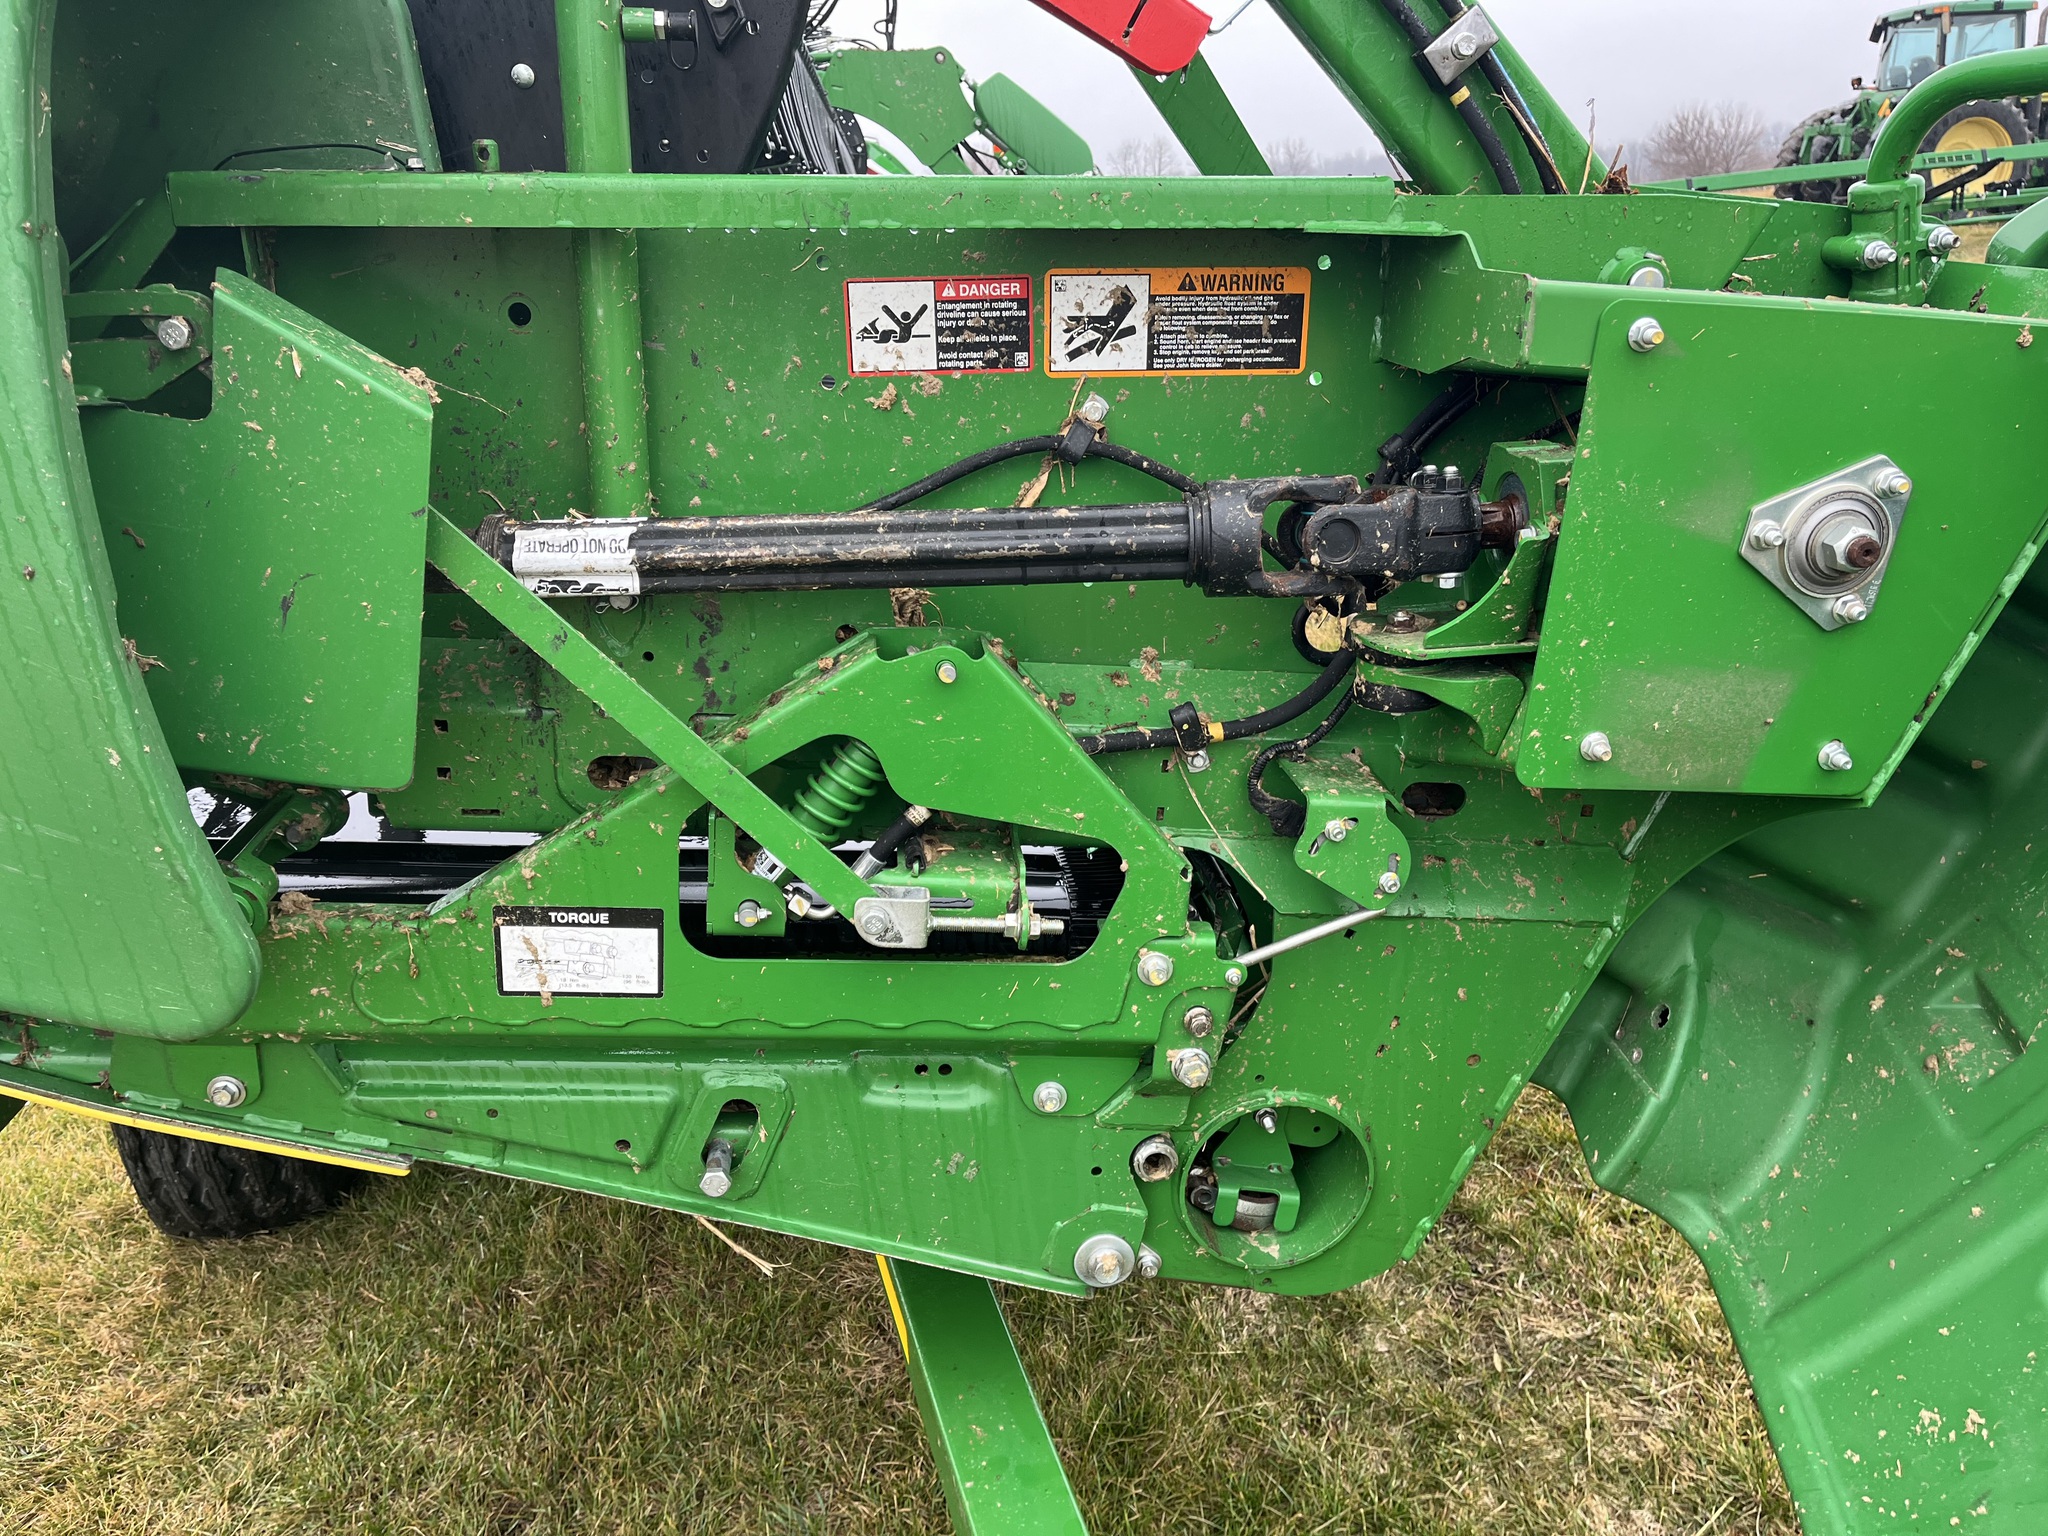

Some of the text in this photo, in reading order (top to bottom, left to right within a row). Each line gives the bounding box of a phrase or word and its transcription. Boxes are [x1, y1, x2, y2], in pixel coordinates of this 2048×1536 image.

[1200, 274, 1284, 291] WARNING
[959, 283, 1020, 296] DANGER
[936, 302, 982, 310] Entanglement
[992, 301, 1017, 309] rotating
[937, 320, 956, 328] injury
[938, 336, 955, 344] Keep
[999, 334, 1018, 343] place.
[939, 360, 985, 368] rotating parts.
[524, 538, 578, 553] OPERATE
[581, 538, 605, 554] NOT
[548, 912, 609, 924] TORQUE
